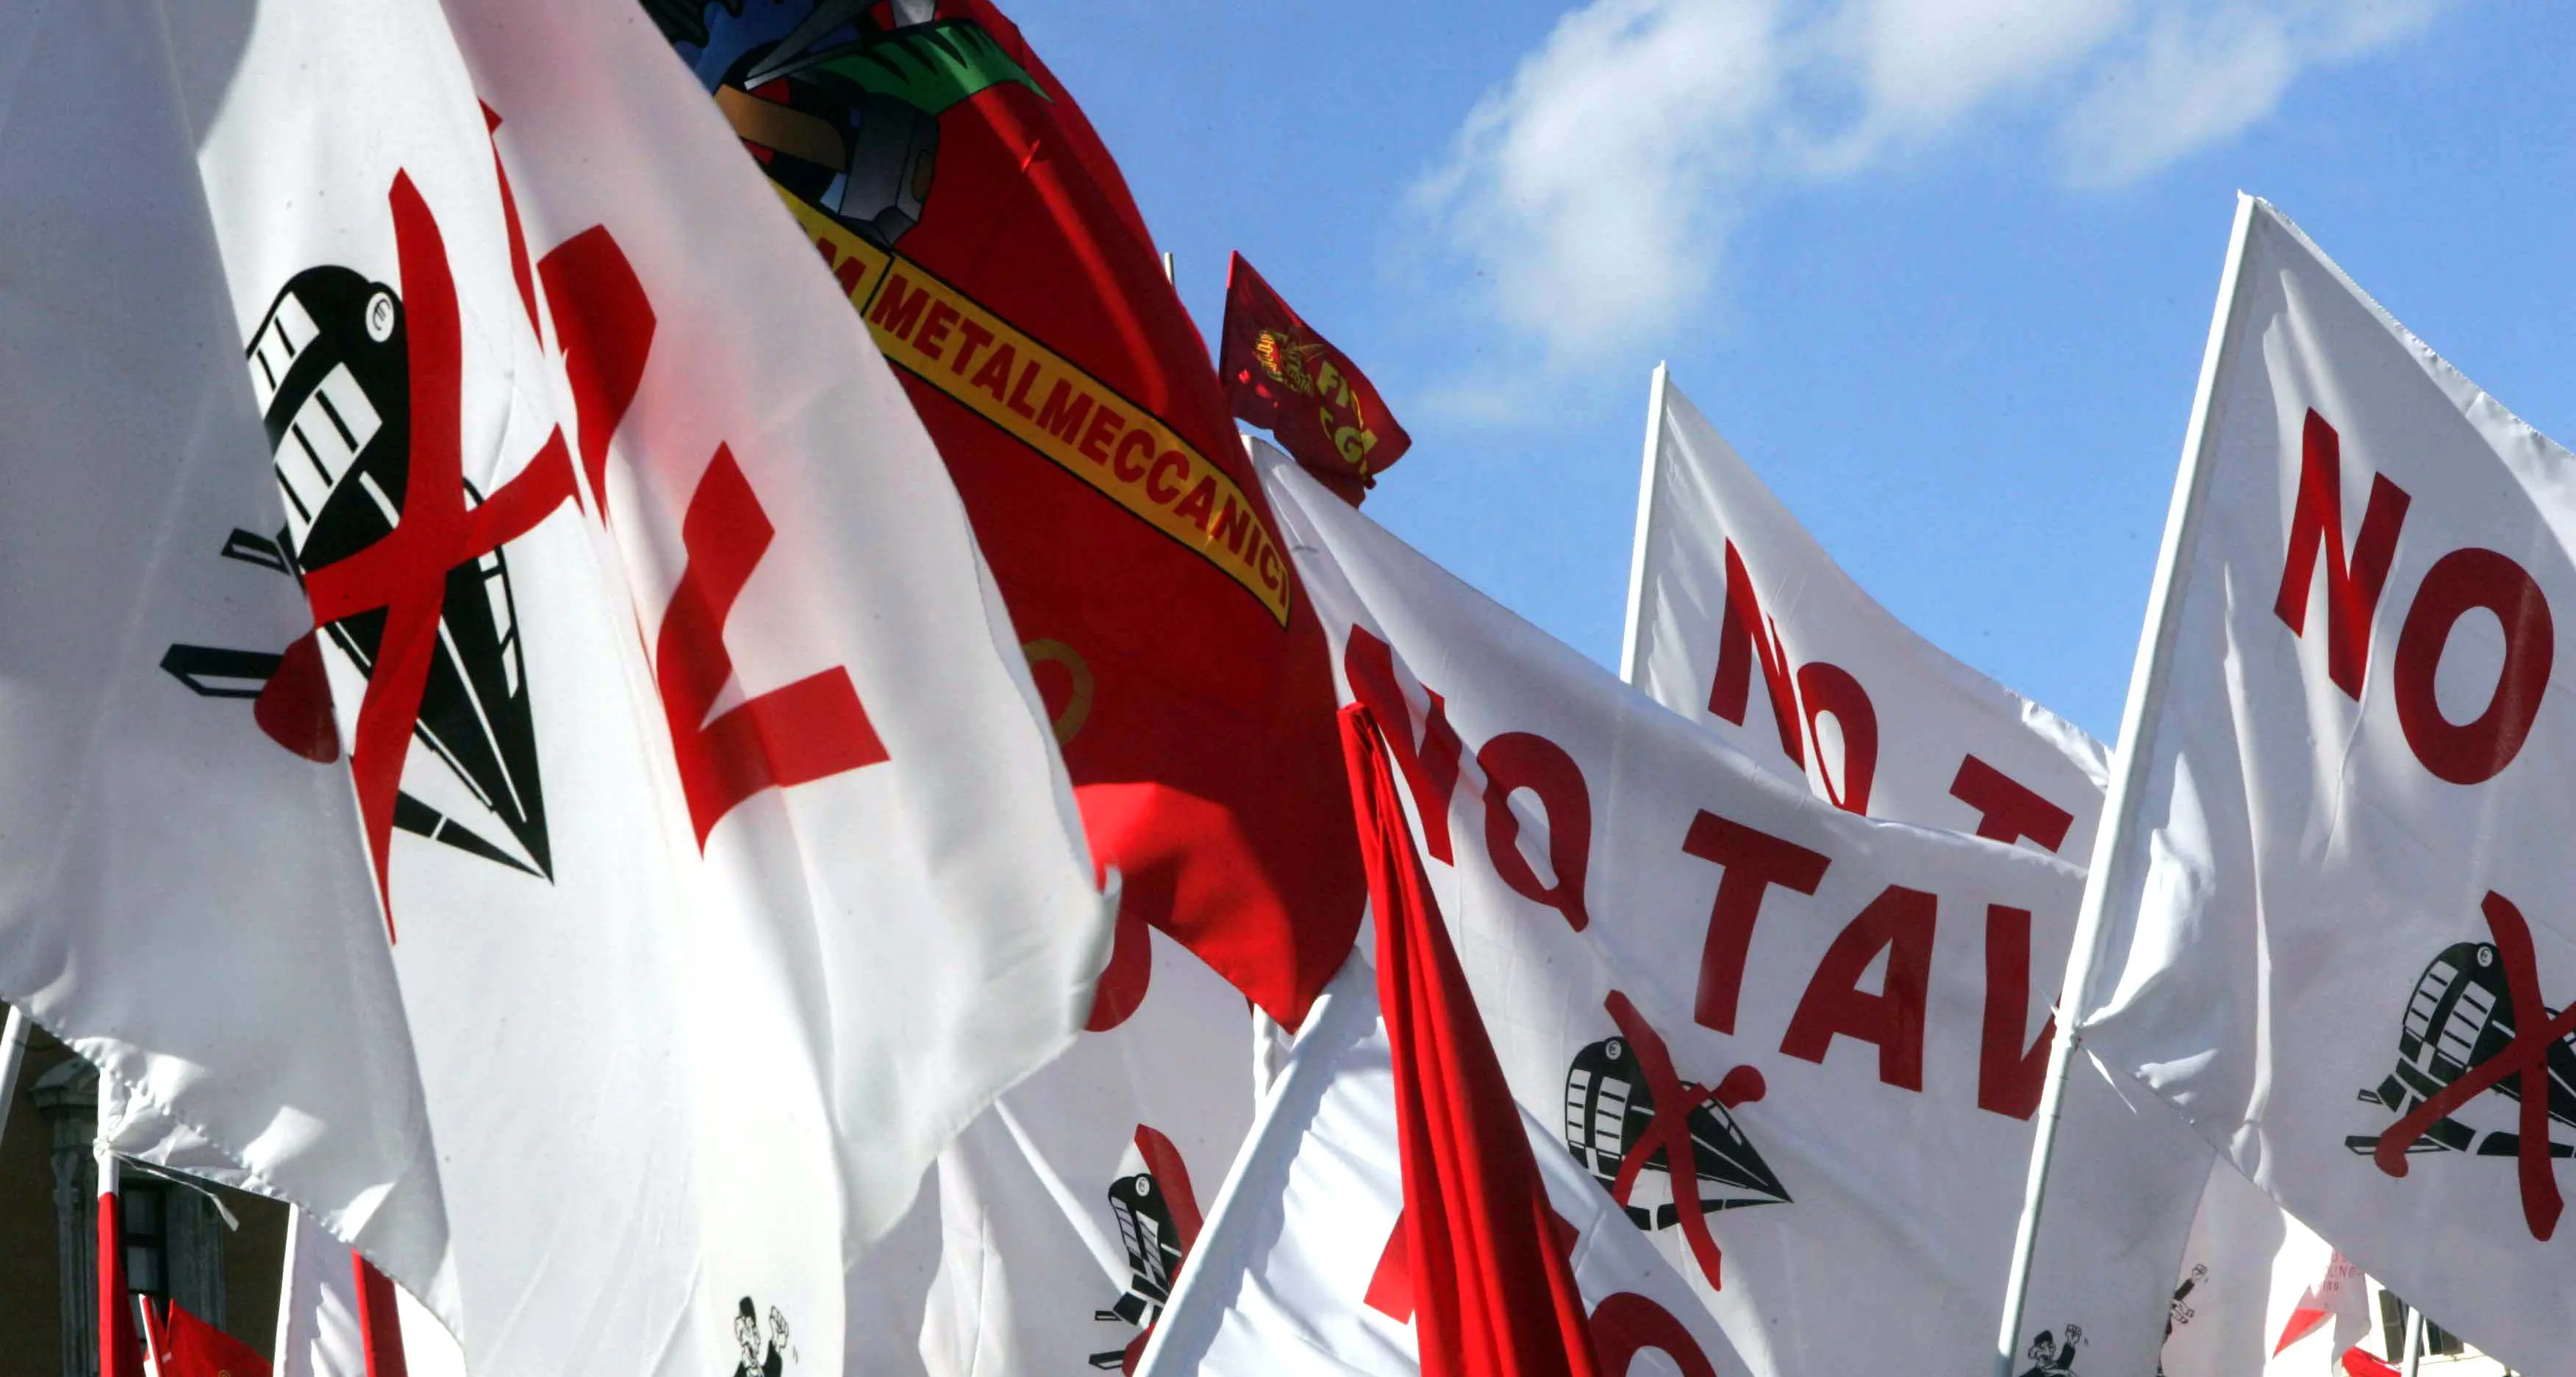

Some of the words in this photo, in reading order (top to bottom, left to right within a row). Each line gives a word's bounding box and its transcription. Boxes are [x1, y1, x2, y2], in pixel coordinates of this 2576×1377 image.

[869, 273, 1287, 609] METALMECCANICI
[2274, 407, 2554, 784] NO
[1345, 623, 1592, 933] NO
[1682, 808, 2061, 1121] TAV
